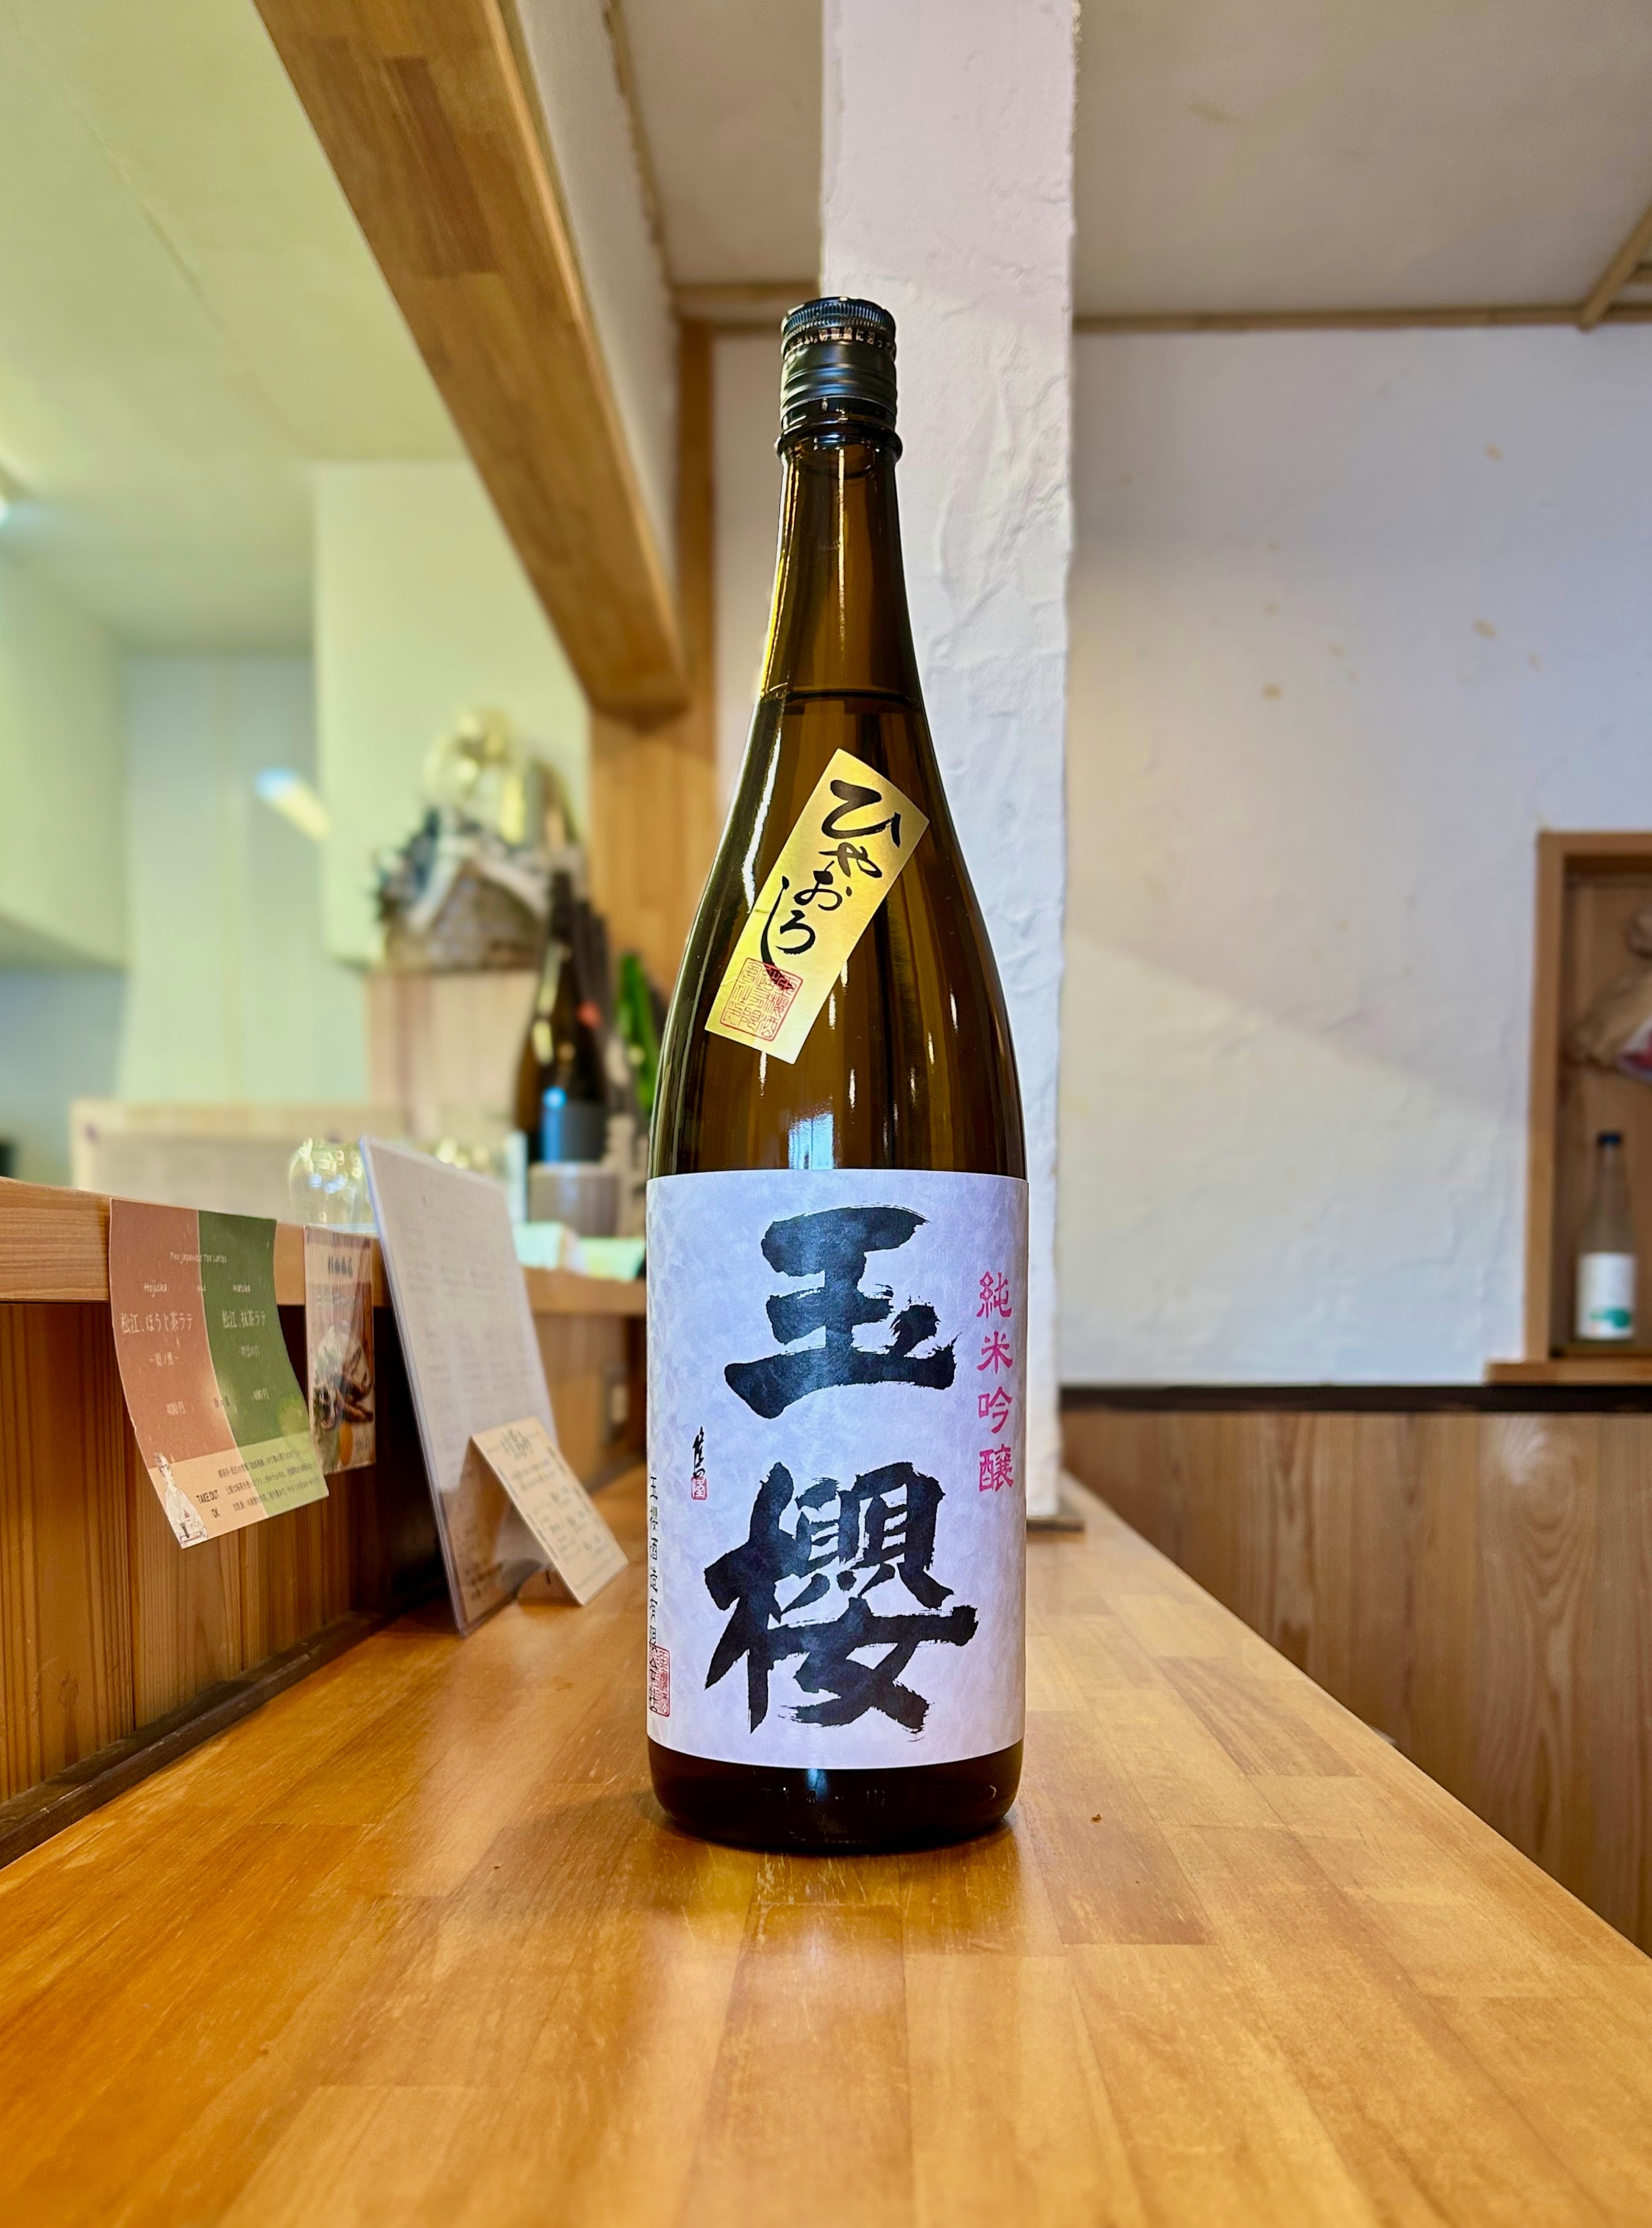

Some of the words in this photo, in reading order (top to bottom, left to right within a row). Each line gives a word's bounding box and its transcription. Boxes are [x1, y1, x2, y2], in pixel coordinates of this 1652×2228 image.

[760, 779, 901, 990] ひやおろし
[705, 1203, 979, 1741] 玉櫻
[976, 1271, 1014, 1492] 純米吟醸
[211, 1508, 221, 1519] OK
